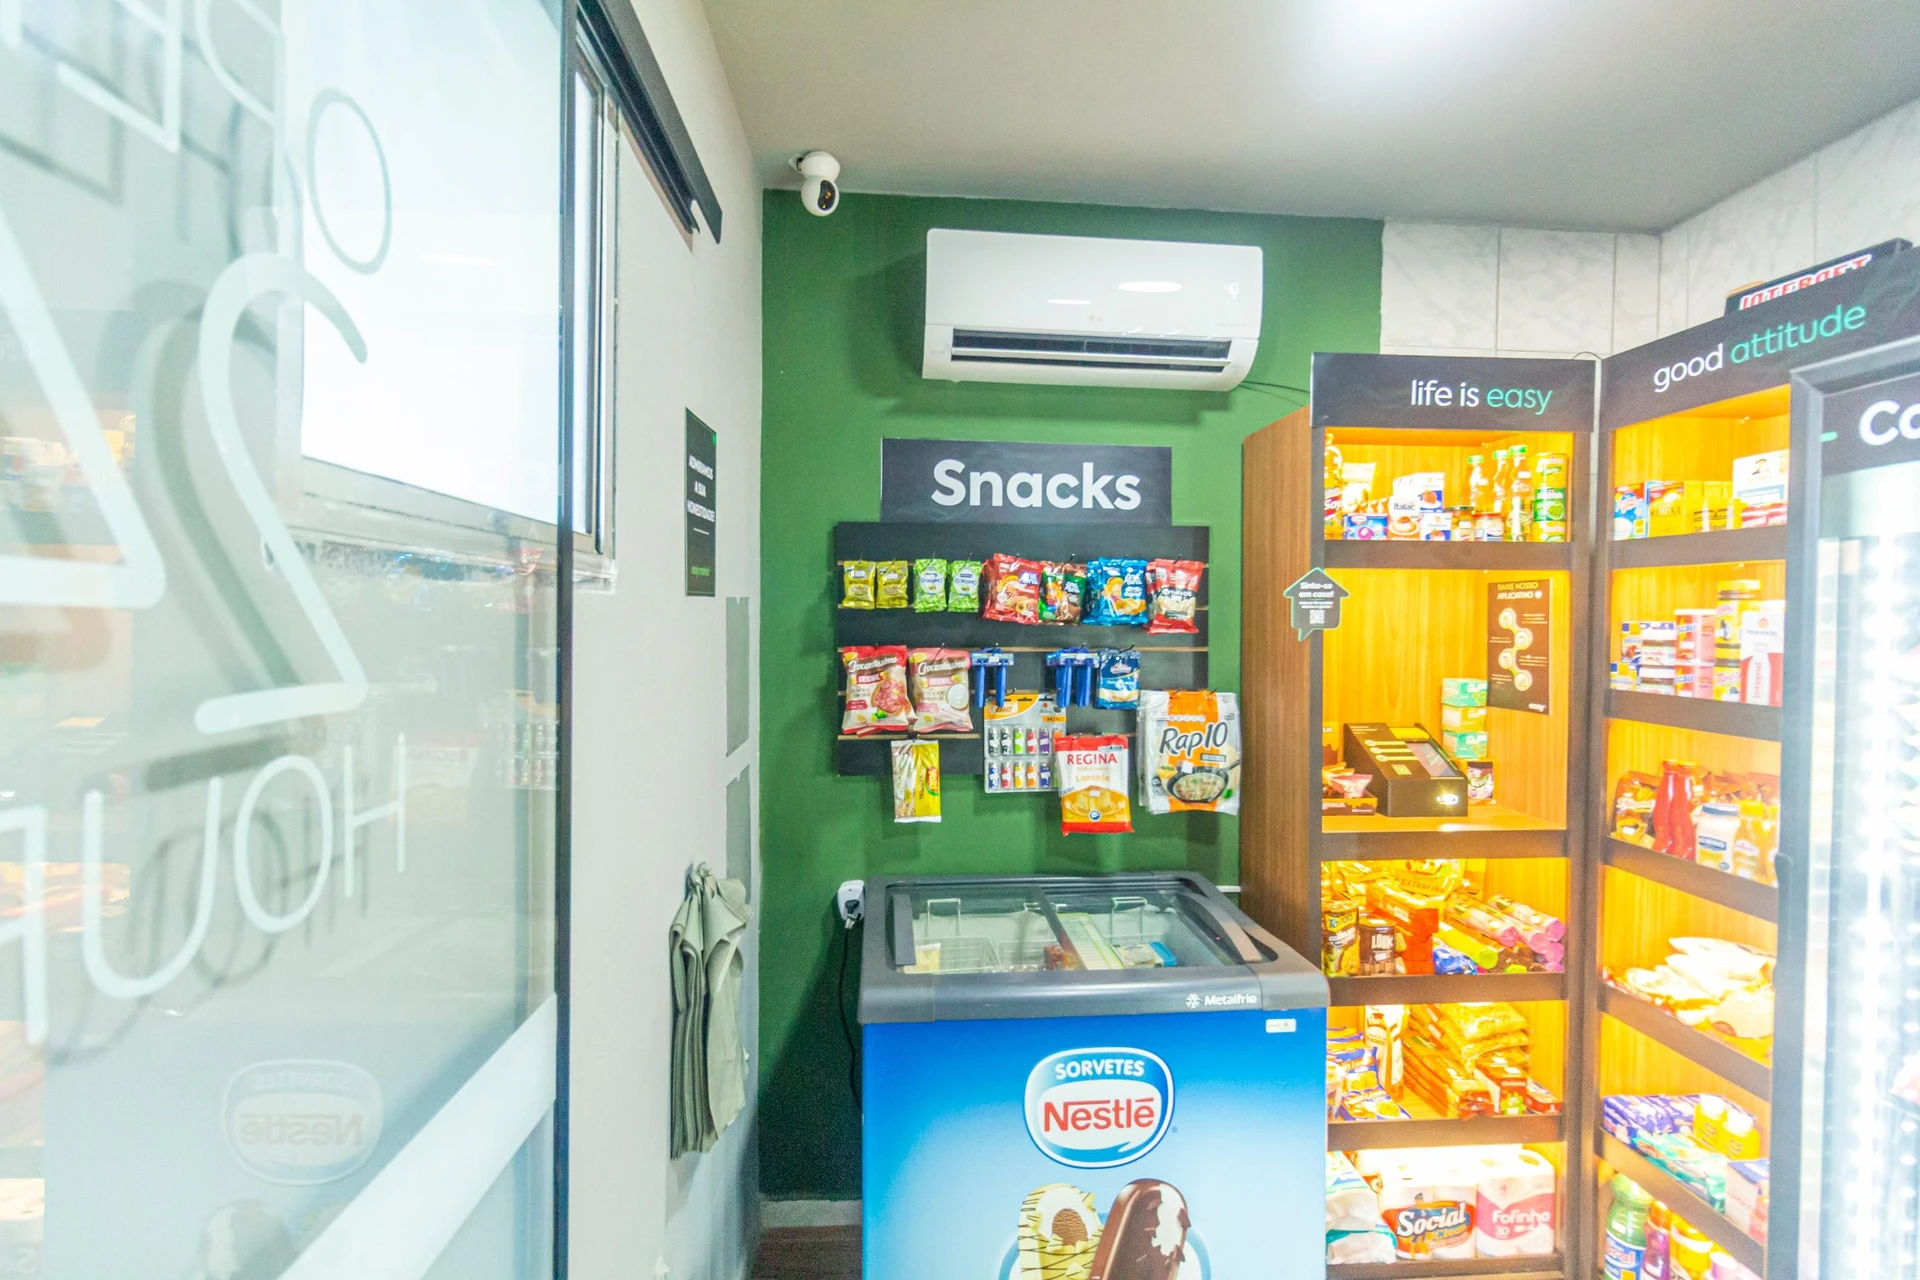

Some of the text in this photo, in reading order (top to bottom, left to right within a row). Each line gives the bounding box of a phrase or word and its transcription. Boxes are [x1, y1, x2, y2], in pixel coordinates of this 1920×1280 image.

[1653, 304, 1867, 393] good attitude
[1411, 379, 1553, 415] life is easy
[931, 459, 1142, 511] Snacks
[1159, 721, 1229, 757] Rap10
[1066, 752, 1118, 765] REGINA
[1204, 993, 1258, 1007] Metalfrio
[1055, 1058, 1145, 1080] SORVETES
[1044, 1097, 1155, 1132] Nestlé
[1396, 1201, 1467, 1238] Social
